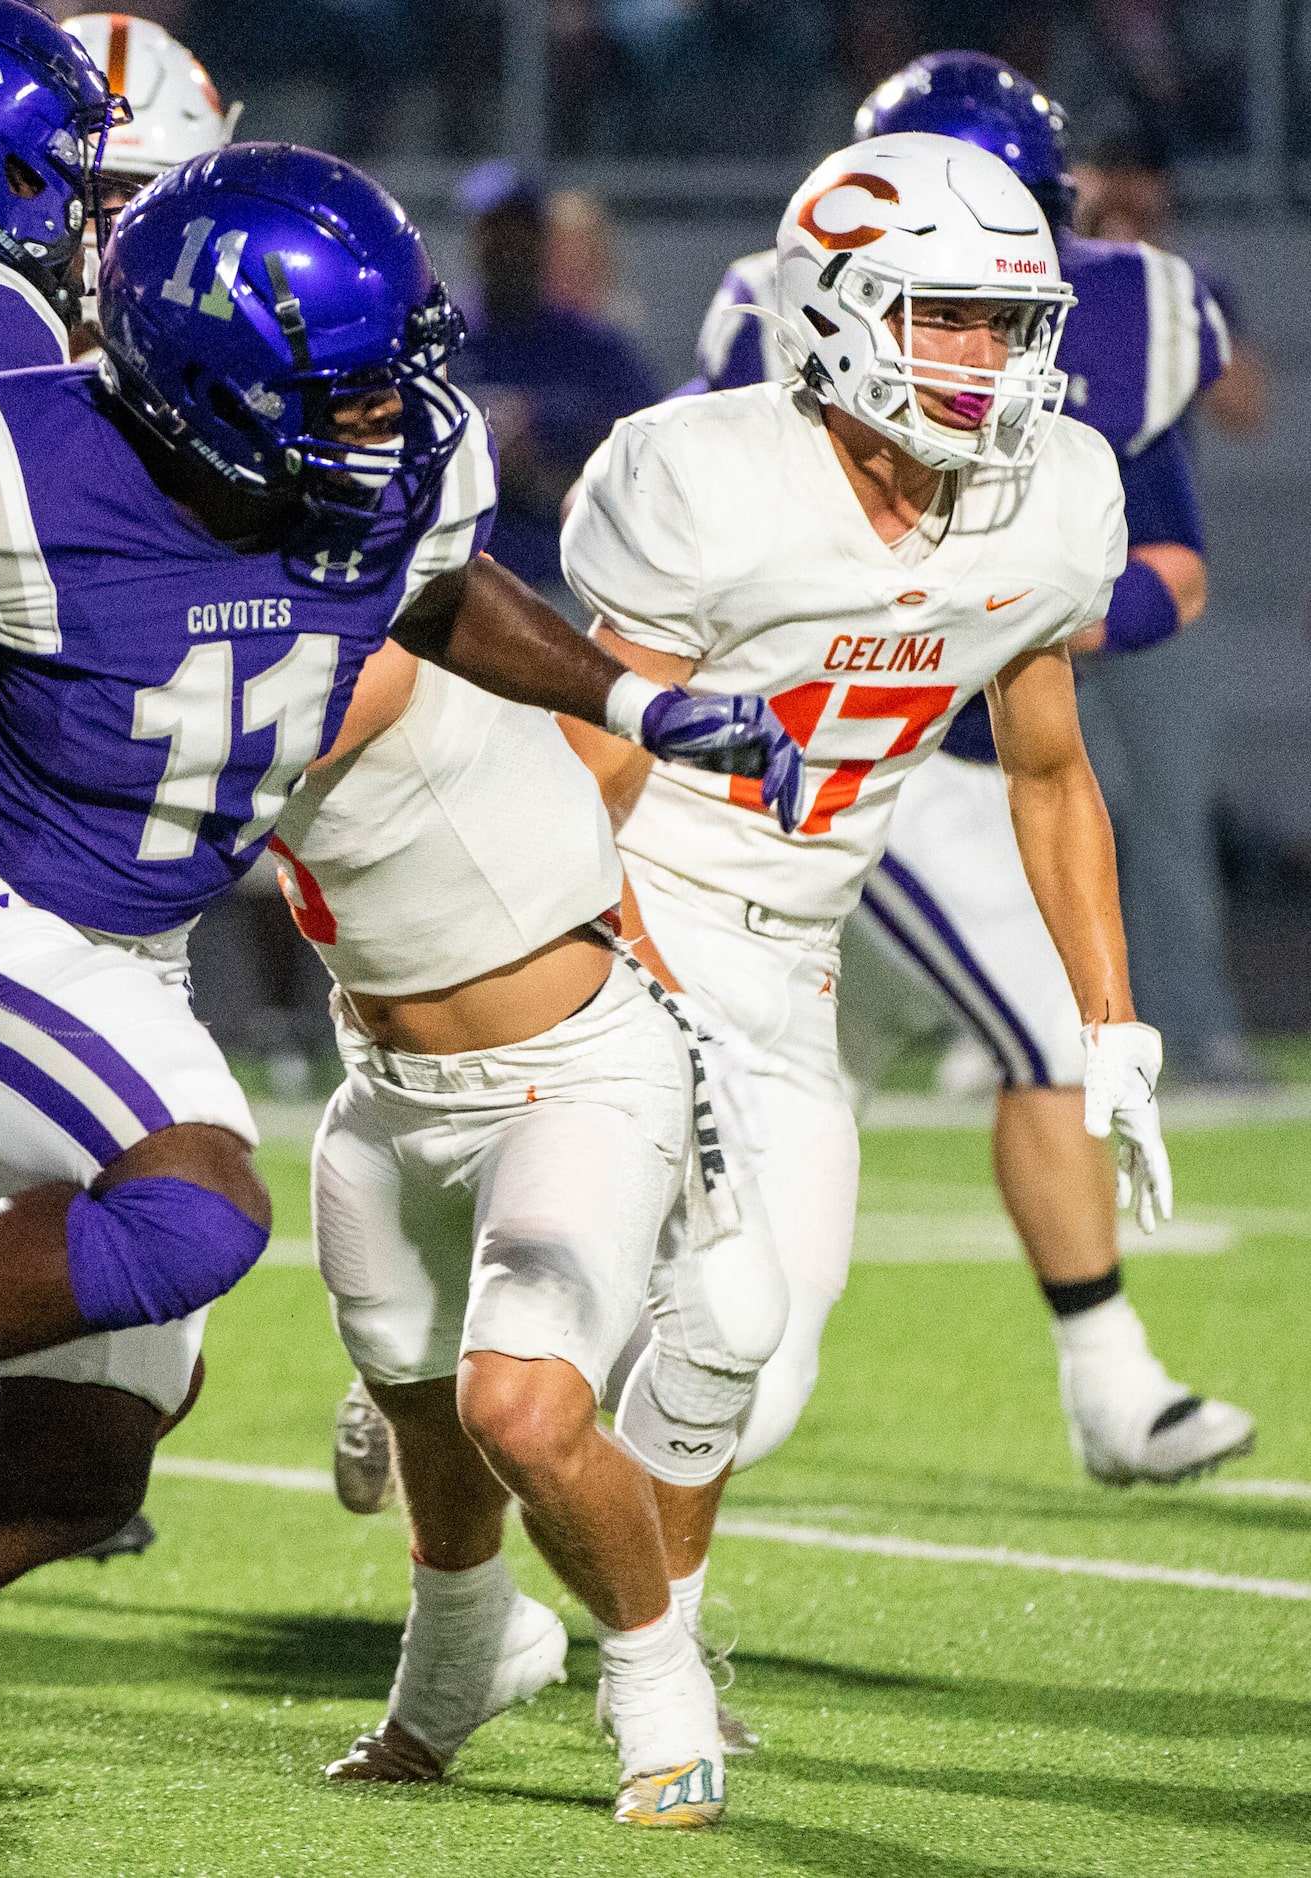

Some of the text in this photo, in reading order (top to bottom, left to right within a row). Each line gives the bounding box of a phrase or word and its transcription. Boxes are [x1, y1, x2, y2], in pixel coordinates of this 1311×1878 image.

[161, 216, 249, 320] 11
[995, 258, 1046, 275] Riddell
[188, 598, 292, 634] COYOTES
[823, 635, 945, 672] CELINA
[131, 633, 340, 861] 11
